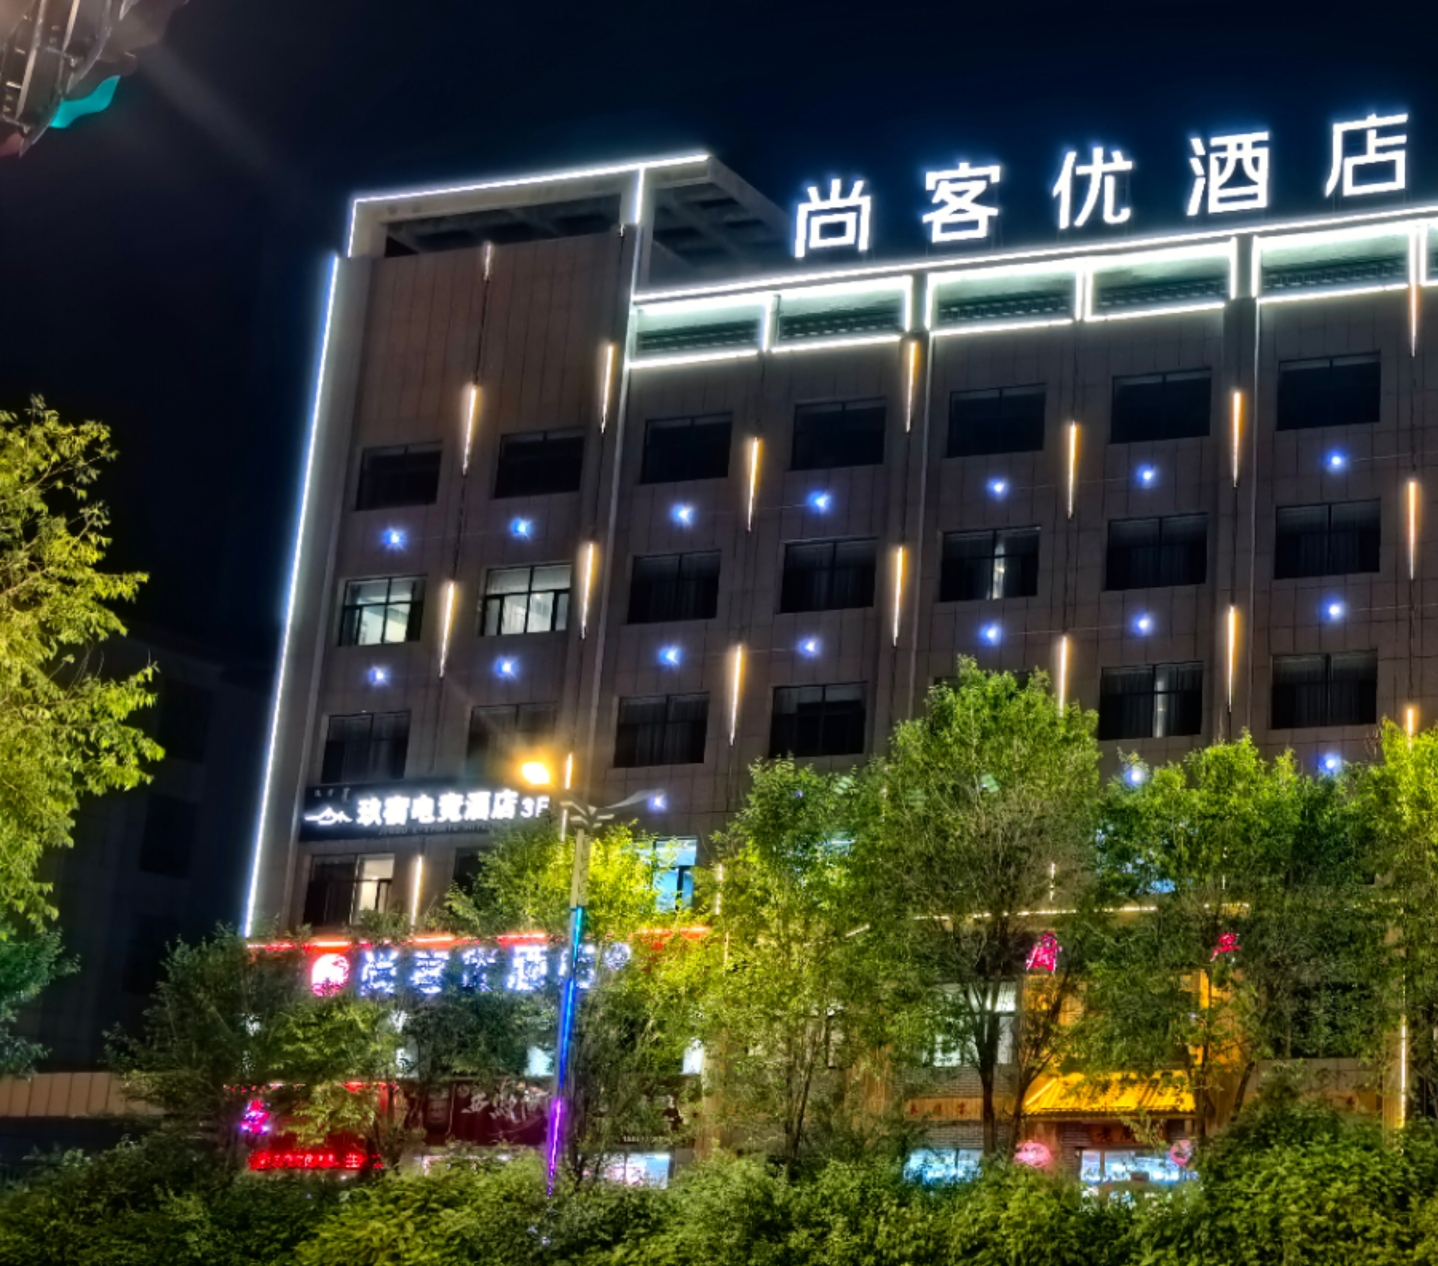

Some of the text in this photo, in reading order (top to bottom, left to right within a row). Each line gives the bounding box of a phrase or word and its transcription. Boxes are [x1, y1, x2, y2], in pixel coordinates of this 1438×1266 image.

[794, 112, 1410, 258] 尚客优酒店
